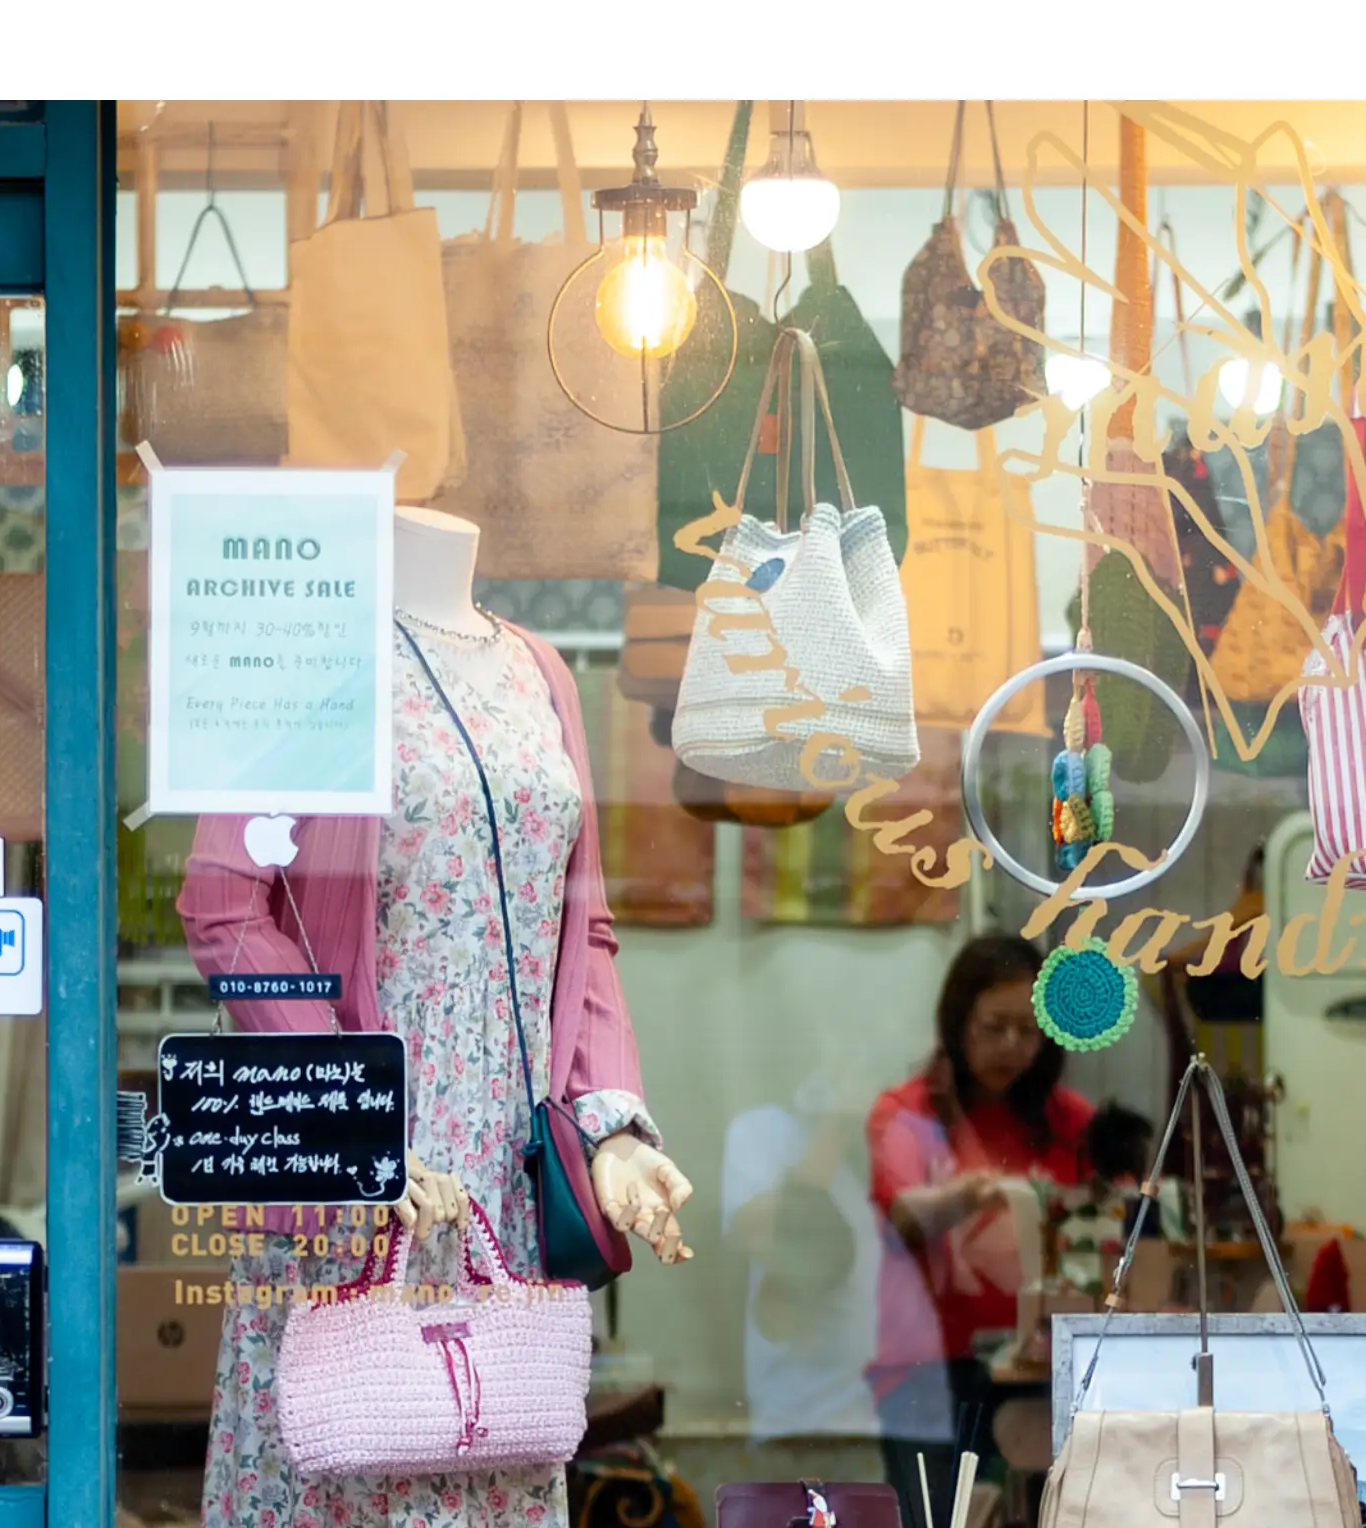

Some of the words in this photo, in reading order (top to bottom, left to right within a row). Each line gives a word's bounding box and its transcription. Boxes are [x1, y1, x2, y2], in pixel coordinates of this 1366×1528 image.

[222, 538, 321, 560] MANO
[187, 579, 295, 597] ARCHIVE
[304, 580, 356, 598] SALE
[186, 696, 223, 712] Every
[230, 697, 266, 710] Piece
[273, 697, 299, 710] Has
[304, 701, 313, 710] a
[319, 697, 355, 711] Hand
[219, 980, 332, 994] 010-8760-1017
[180, 1059, 225, 1087] 저희
[232, 1064, 302, 1084] mano
[260, 1125, 301, 1149] class
[171, 1204, 265, 1227] OPEN
[291, 1204, 390, 1227] 11:00
[171, 1233, 265, 1257] CLOSE
[292, 1233, 390, 1257] 20:00
[176, 1279, 339, 1310] Instagram
